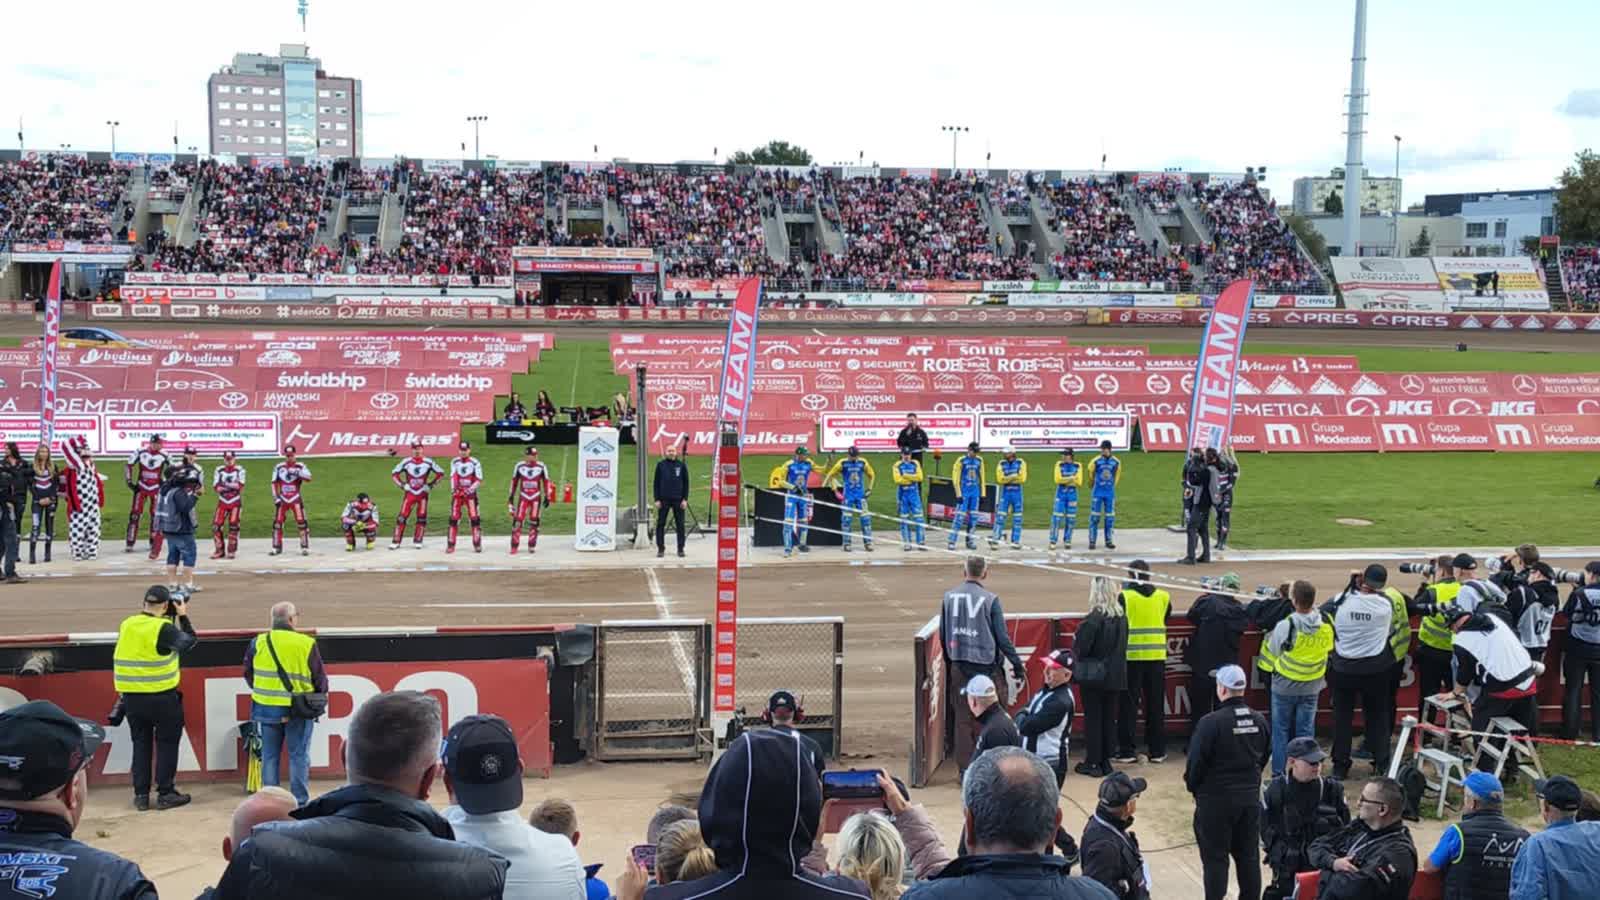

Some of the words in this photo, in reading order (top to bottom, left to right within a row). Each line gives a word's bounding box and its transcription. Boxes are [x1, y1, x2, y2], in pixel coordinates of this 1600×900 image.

[1303, 313, 1359, 325] PRES
[1391, 315, 1449, 327] PRES
[722, 310, 754, 421] TEAM
[788, 360, 841, 369] SECURITY
[863, 360, 916, 369] SECURITY
[1198, 311, 1241, 419] TEAM
[277, 371, 367, 391] światbhp
[404, 372, 494, 392] światbhp
[1235, 403, 1322, 415] EMETICA
[1386, 399, 1433, 415] JKG
[1488, 400, 1536, 416] JKG
[1312, 422, 1344, 434] Grupa
[1428, 422, 1460, 434] Grupa
[1541, 423, 1574, 435] Grupa
[329, 431, 454, 446] Metalkas
[694, 431, 809, 445] Malkas
[1315, 433, 1372, 445] Moderator
[1431, 433, 1488, 445] Moderator
[588, 470, 610, 478] TEAM
[949, 593, 986, 618] TV
[1350, 611, 1372, 621] FOTO
